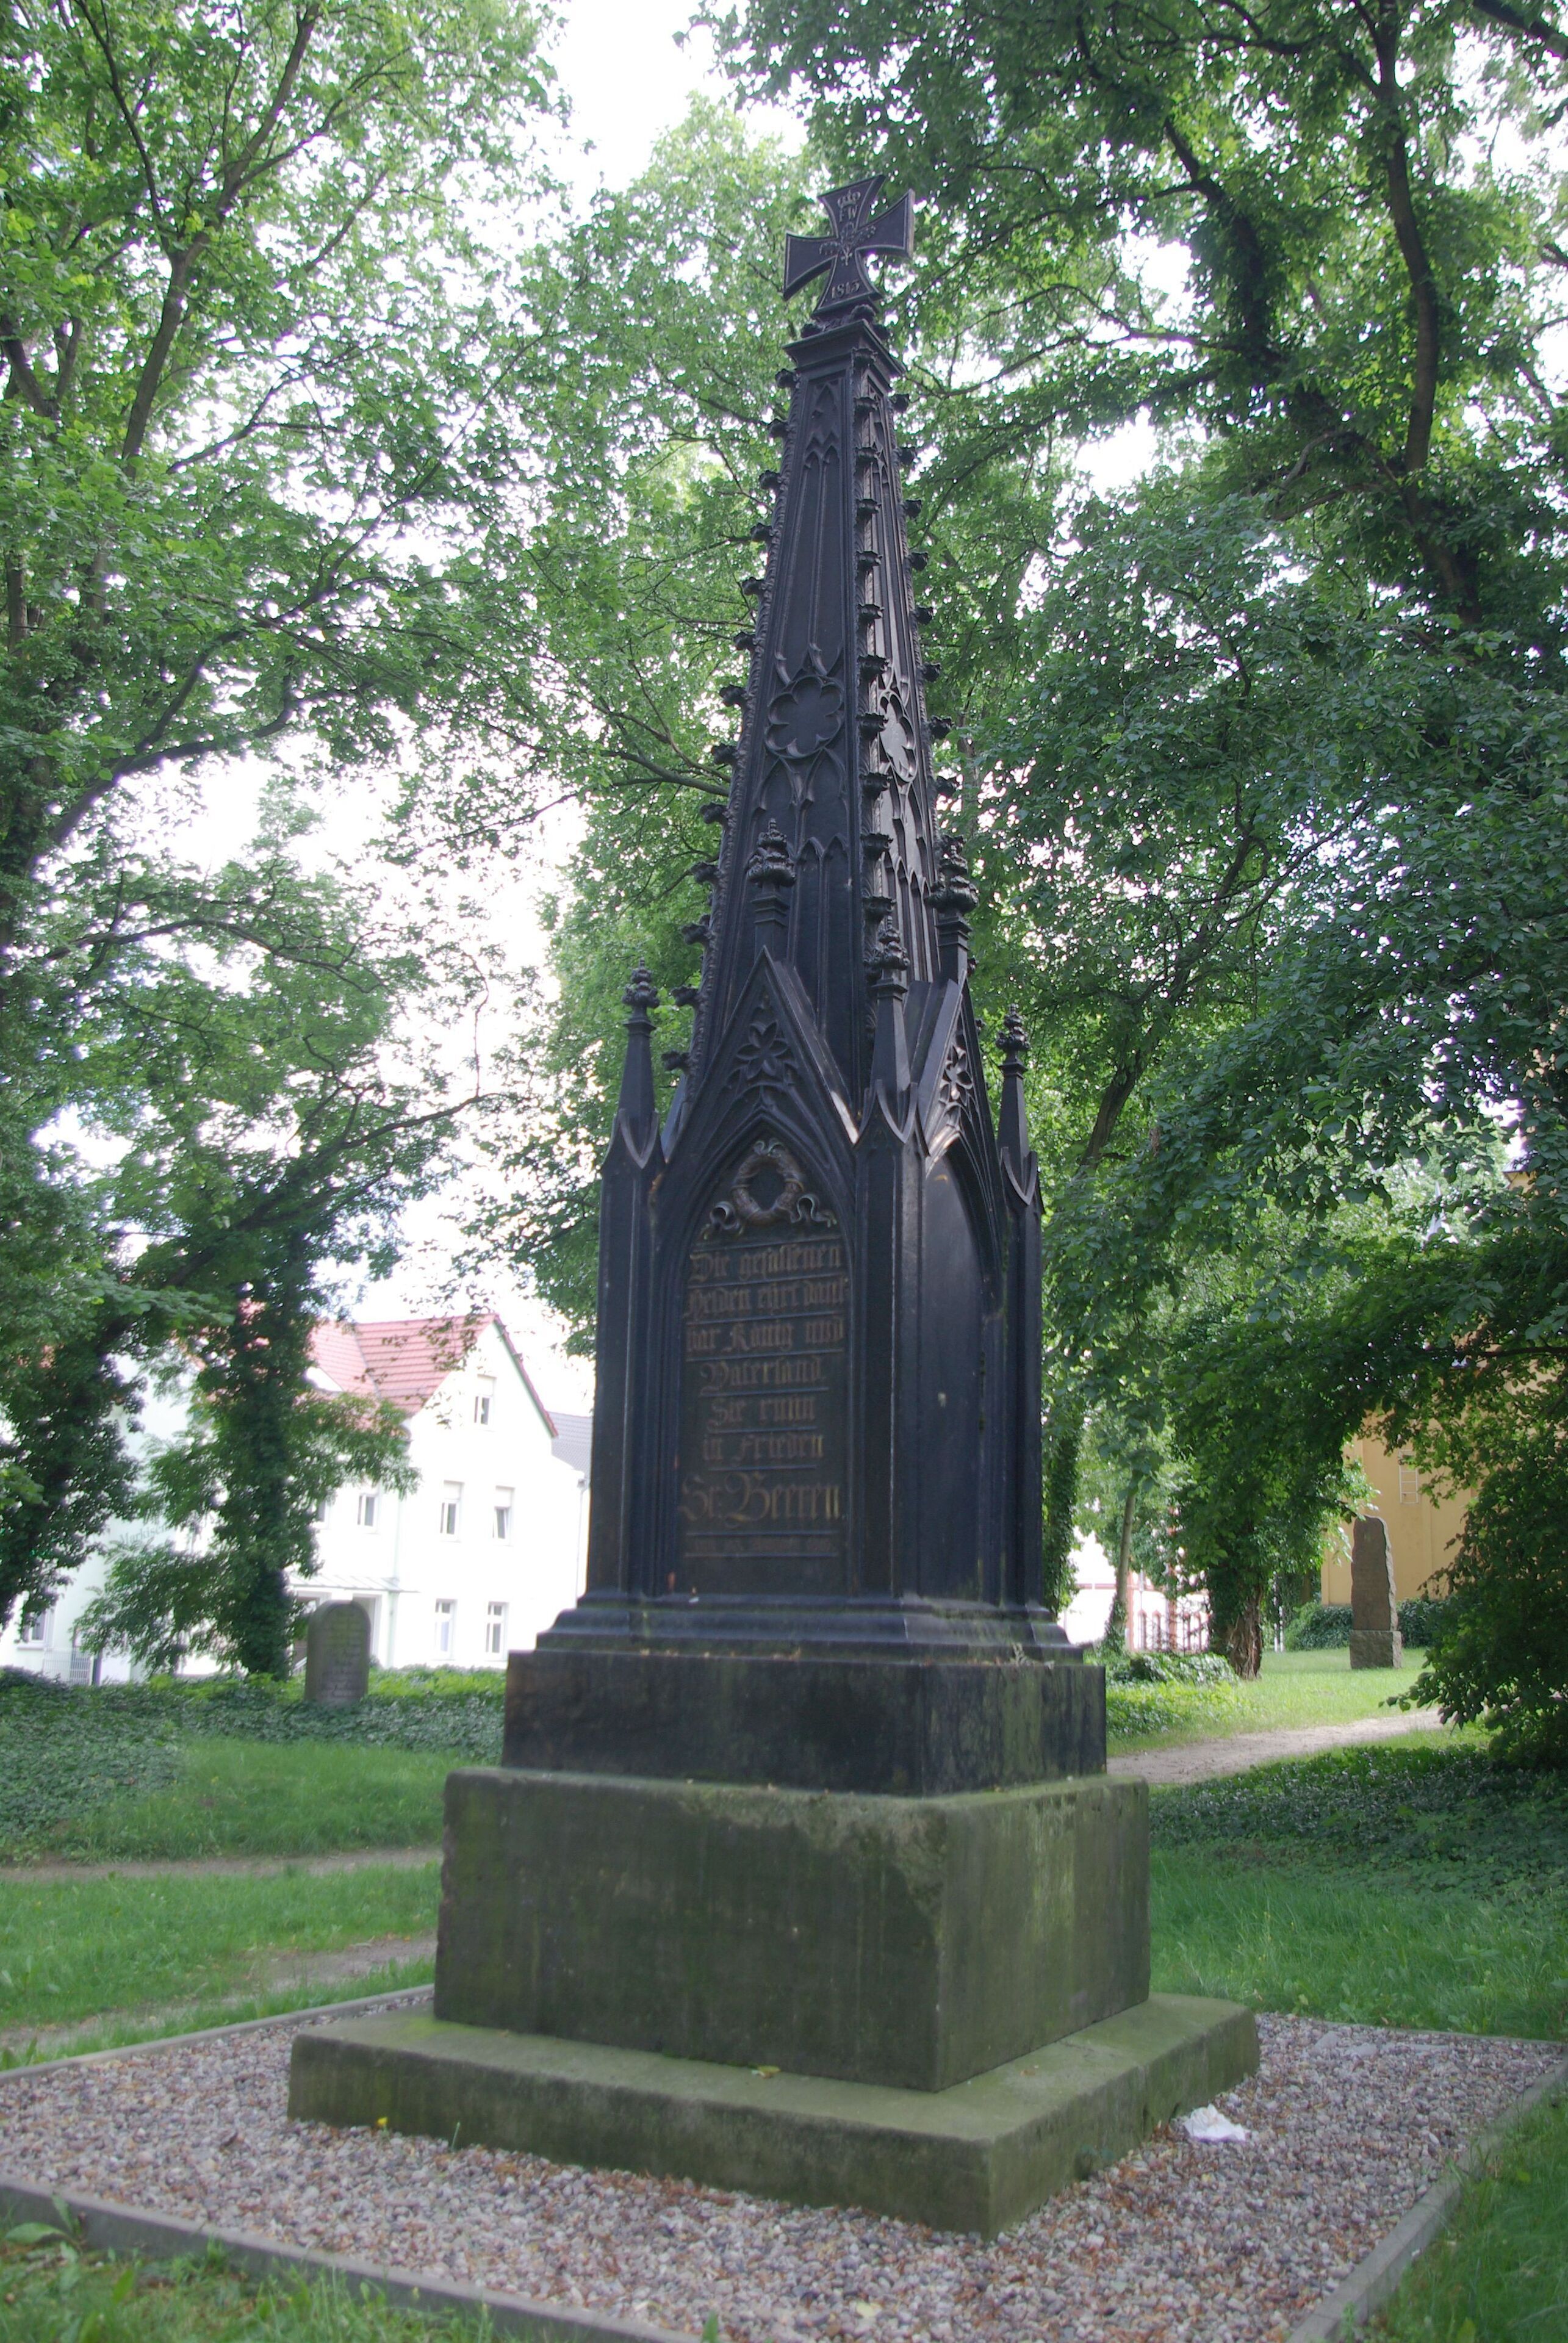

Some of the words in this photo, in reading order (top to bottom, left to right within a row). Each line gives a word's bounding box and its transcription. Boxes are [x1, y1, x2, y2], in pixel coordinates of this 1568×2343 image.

[832, 282, 860, 299] 1813
[689, 1254, 730, 1281] Die
[739, 1244, 841, 1281] gefallenen
